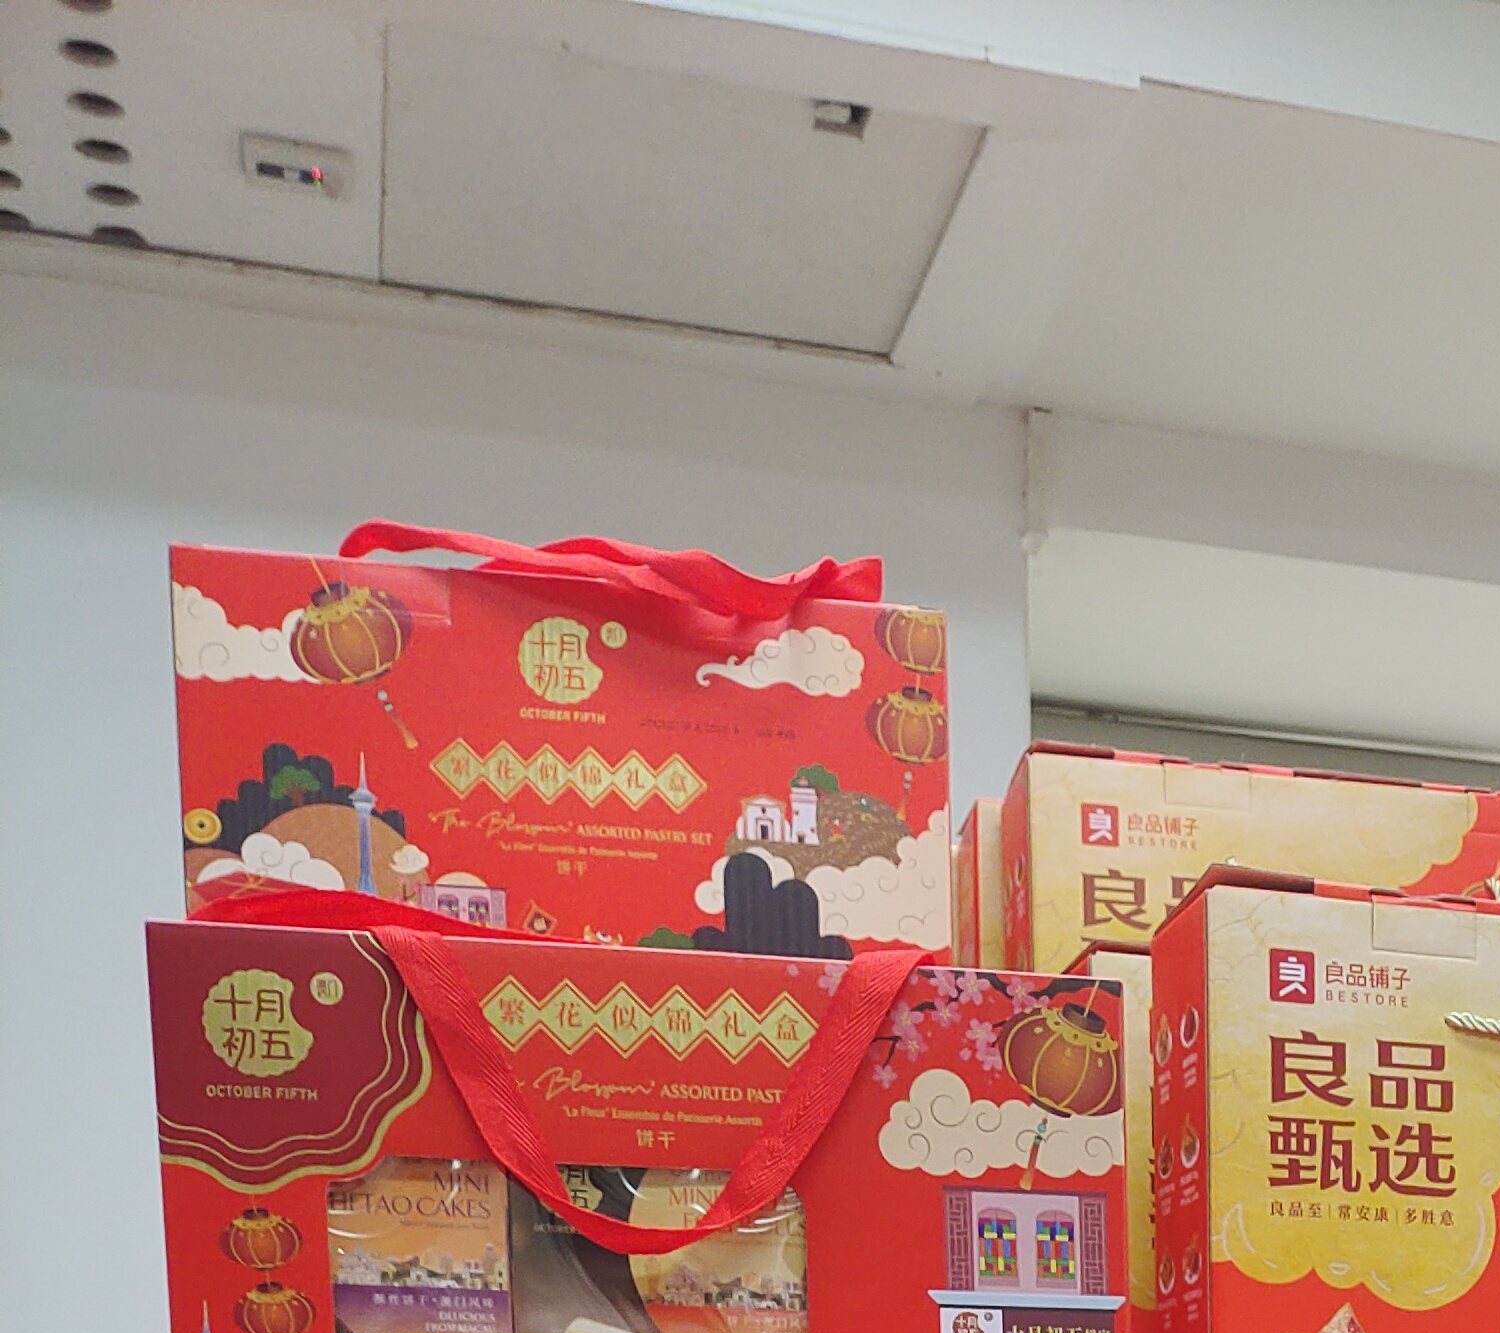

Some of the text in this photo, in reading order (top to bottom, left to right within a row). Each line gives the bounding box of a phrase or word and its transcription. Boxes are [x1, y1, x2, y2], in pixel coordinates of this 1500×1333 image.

[529, 630, 582, 661] 十月
[533, 664, 585, 699] 初五
[520, 707, 606, 724] OCTOBER FIFTH
[576, 825, 641, 841] ASSORTED
[644, 828, 689, 845] PASTRY
[691, 831, 714, 846] SET
[1127, 813, 1199, 836] 良品铺子
[1128, 836, 1198, 851] BESTORE
[1325, 962, 1412, 991] 良品铺子
[213, 984, 285, 1023] 十月
[1325, 990, 1410, 1009] BESTORE
[499, 998, 800, 1042] 繁花似锦礼盒
[222, 1027, 294, 1068] 初五
[1268, 1030, 1455, 1114] 良品
[206, 1084, 319, 1101] OCTOBER FIFTH
[660, 1083, 744, 1102] ASSORTED
[747, 1086, 784, 1104] PAST
[1267, 1114, 1458, 1199] 甄选
[433, 1170, 491, 1195] MINI
[416, 1195, 492, 1219] CAKES
